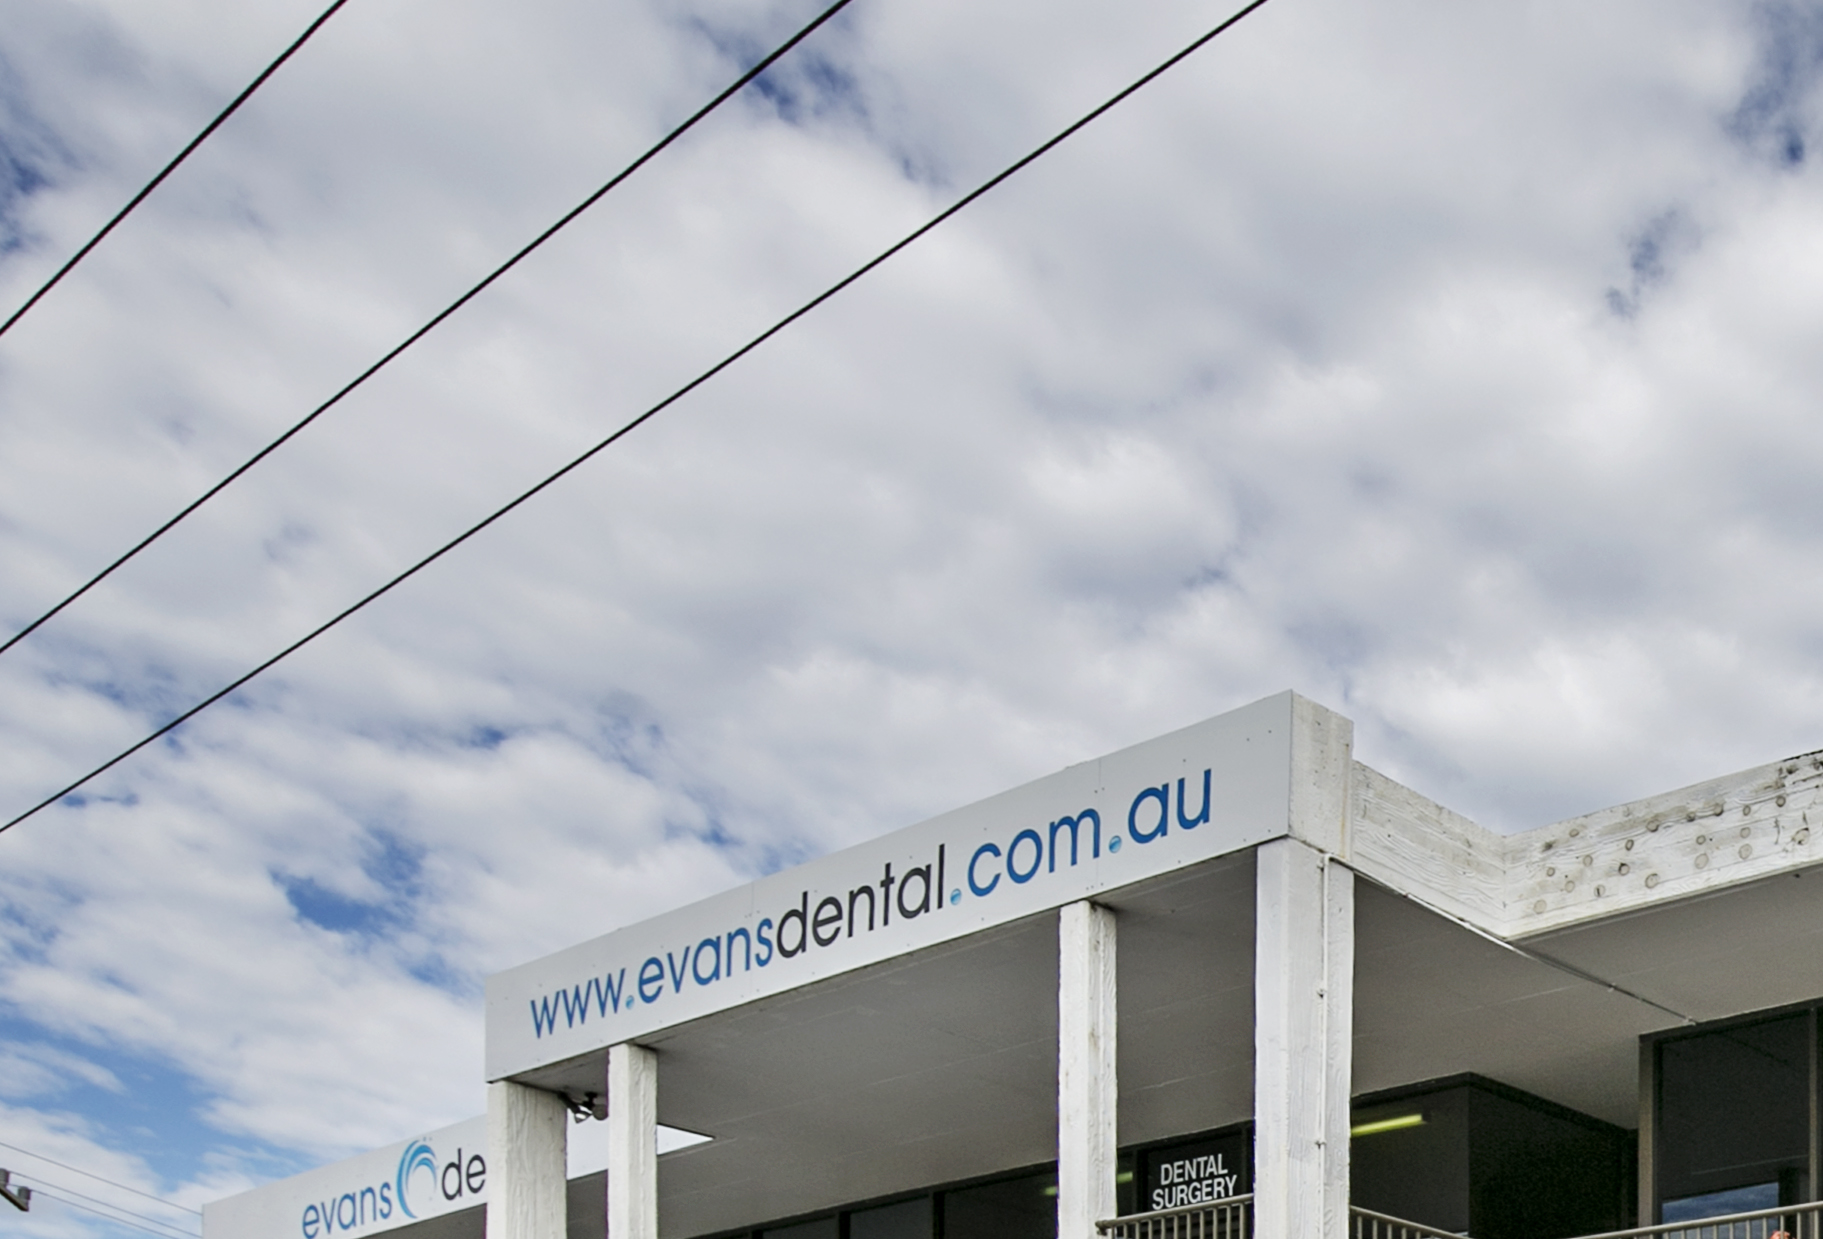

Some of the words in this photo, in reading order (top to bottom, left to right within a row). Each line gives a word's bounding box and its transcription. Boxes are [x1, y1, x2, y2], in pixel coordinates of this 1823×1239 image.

[530, 768, 1213, 1040] www.evansdental.com.au
[1160, 1153, 1228, 1186] DENTAL
[1152, 1174, 1237, 1212] SURGERY
